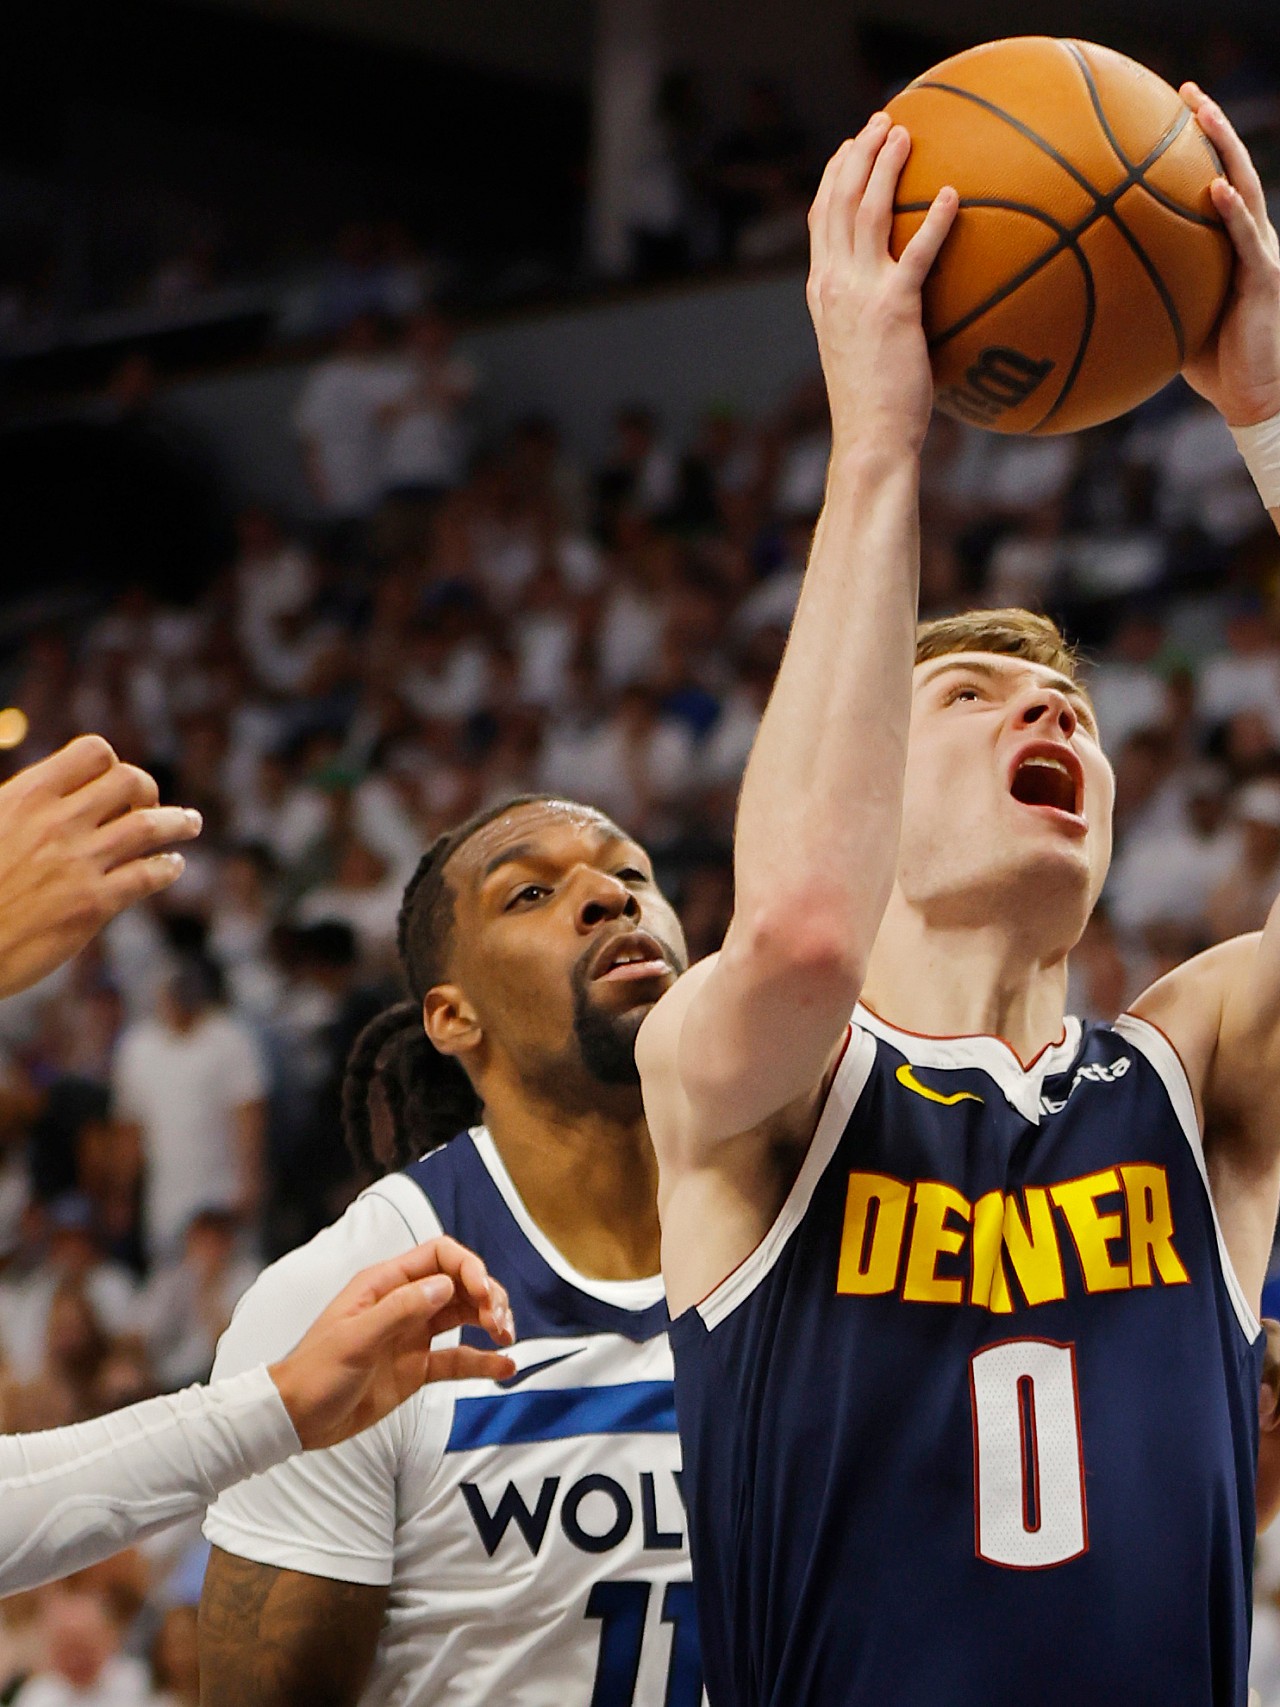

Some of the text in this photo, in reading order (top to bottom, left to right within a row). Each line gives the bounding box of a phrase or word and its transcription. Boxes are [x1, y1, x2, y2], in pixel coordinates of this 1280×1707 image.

[836, 1161, 1192, 1314] DENVER
[968, 1336, 1089, 1571] 0
[584, 1581, 704, 1707] 11
